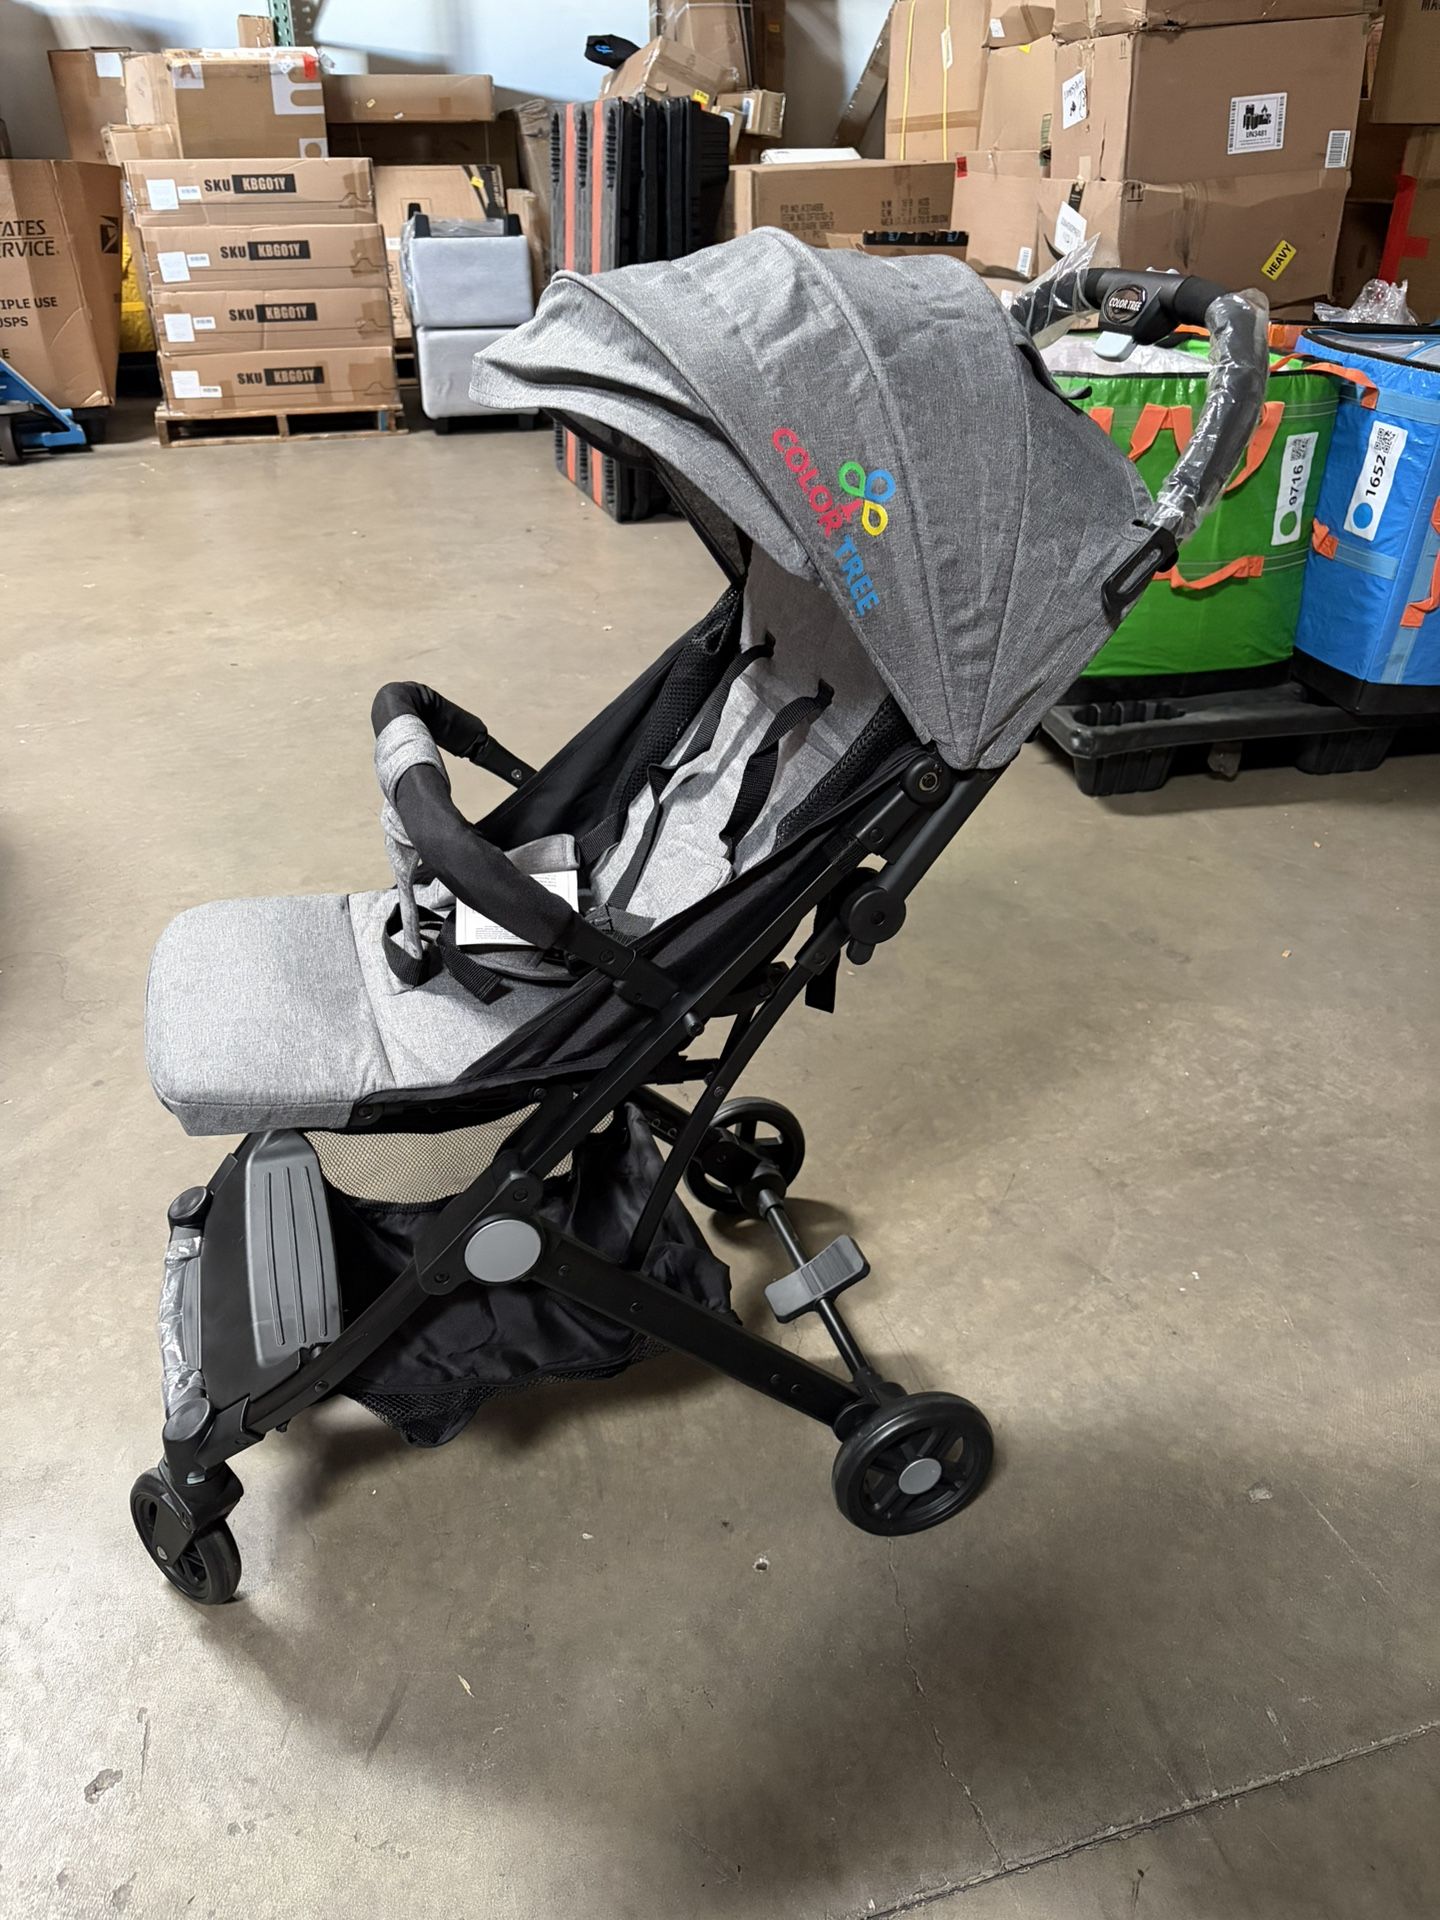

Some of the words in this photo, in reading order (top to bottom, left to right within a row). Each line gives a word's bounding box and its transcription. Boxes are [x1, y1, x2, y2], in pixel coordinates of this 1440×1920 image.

[204, 179, 231, 192] SKU
[220, 245, 247, 259] SKU
[1266, 244, 1292, 276] HEAVY
[34, 296, 58, 308] USE
[1108, 297, 1129, 310] COLOR
[1127, 300, 1143, 312] TREE
[228, 308, 255, 322] SKU
[237, 372, 263, 385] SKU
[1365, 454, 1387, 497] 1652
[772, 427, 843, 539] COLOR
[834, 533, 880, 618] TREE
